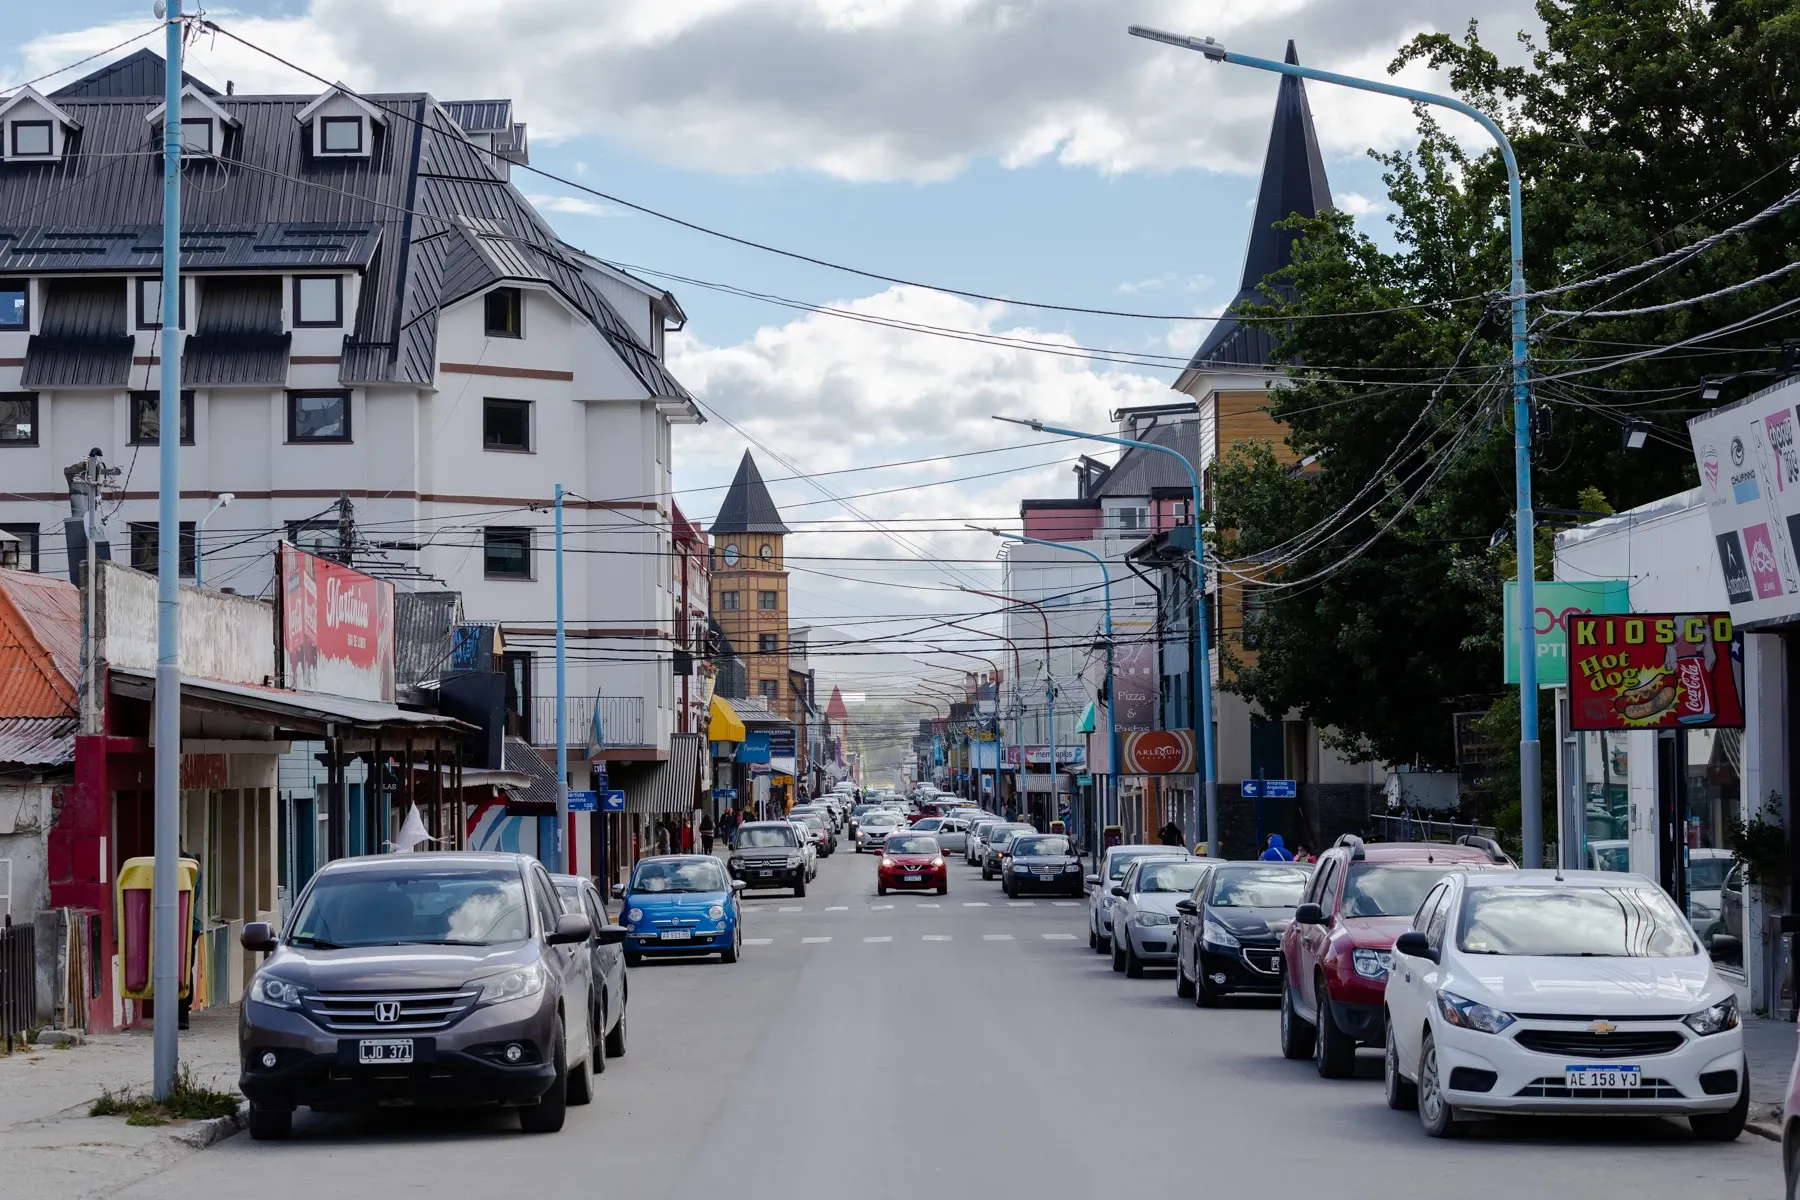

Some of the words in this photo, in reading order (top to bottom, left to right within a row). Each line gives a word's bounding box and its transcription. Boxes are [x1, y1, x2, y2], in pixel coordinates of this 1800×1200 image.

[1577, 617, 1733, 645] KIOSCO
[1578, 650, 1630, 679] Hot
[1590, 667, 1641, 692] dog
[1118, 690, 1146, 701] Pizza
[1126, 708, 1137, 719] &
[1114, 724, 1150, 733] Pastas
[361, 1045, 384, 1059] LJO
[389, 1045, 411, 1059] 371
[1570, 1072, 1586, 1086] AE
[1591, 1072, 1616, 1087] 158
[1620, 1073, 1637, 1087] YJ
